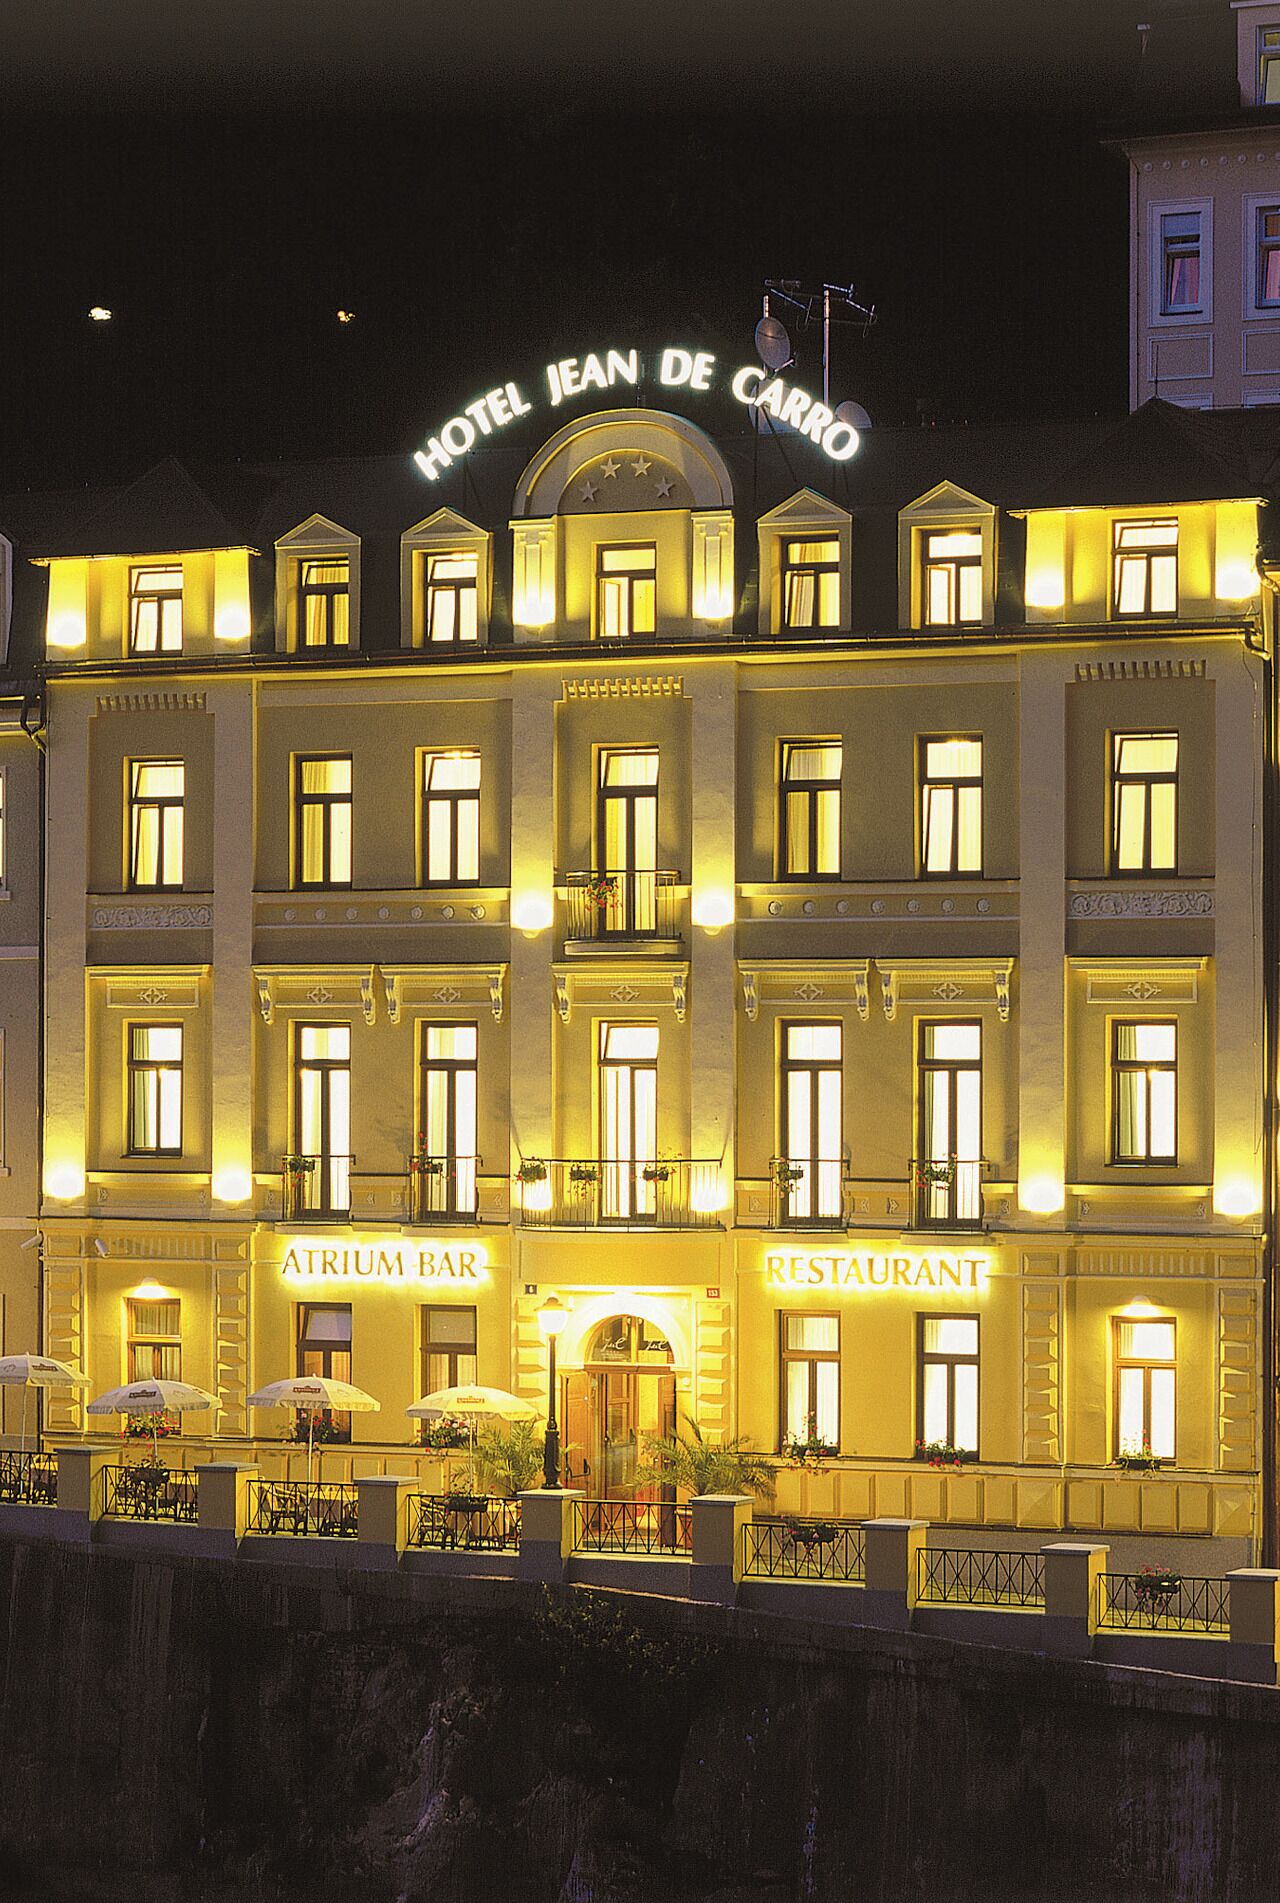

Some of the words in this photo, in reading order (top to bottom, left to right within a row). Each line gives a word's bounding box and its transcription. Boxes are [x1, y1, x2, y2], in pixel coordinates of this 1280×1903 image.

[414, 381, 531, 481] HOTEL
[547, 349, 638, 407] JEAN
[660, 348, 715, 390] DE
[732, 366, 860, 461] CARRO
[282, 1248, 404, 1276] ATRIUM
[419, 1251, 477, 1278] BAR
[767, 1256, 986, 1287] RESTAURANT
